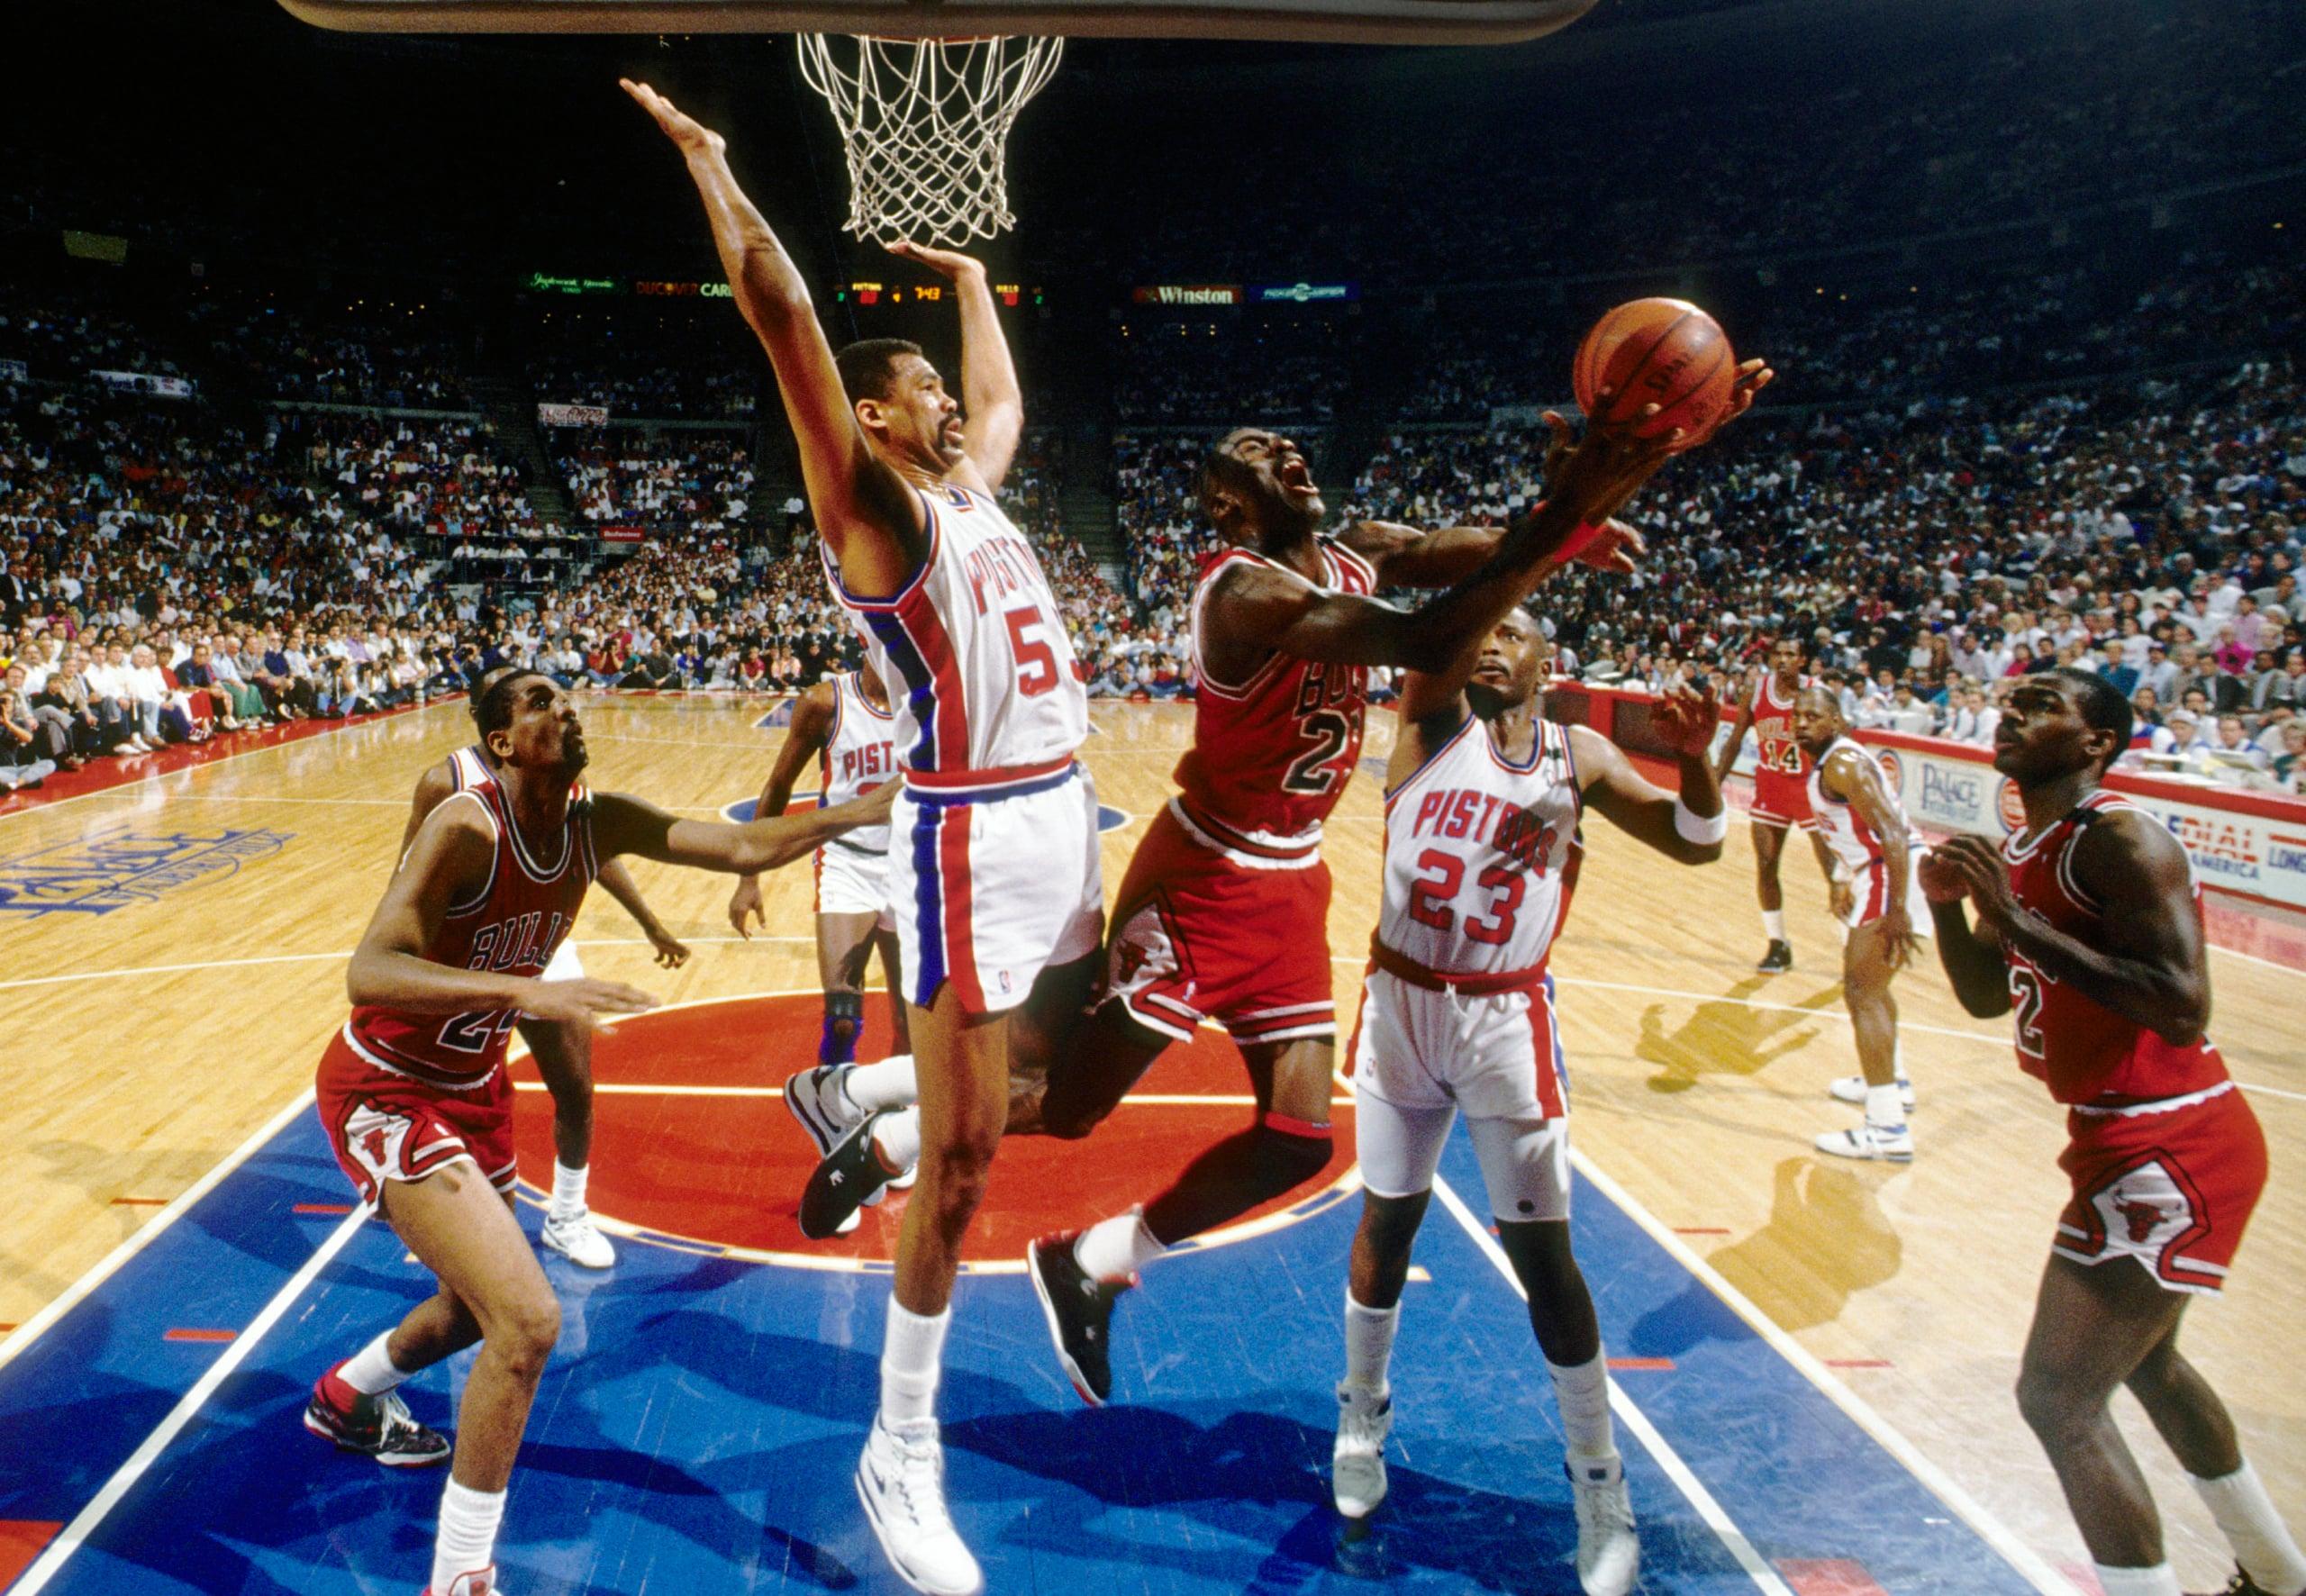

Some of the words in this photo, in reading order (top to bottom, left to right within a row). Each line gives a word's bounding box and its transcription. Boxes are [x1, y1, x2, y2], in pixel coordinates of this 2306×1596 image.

[1158, 286, 1233, 304] Winston
[1004, 604, 1085, 699] 5
[843, 740, 901, 782] PIST
[1765, 739, 1802, 774] 14
[1412, 789, 1557, 879] PISTONS
[1409, 848, 1526, 945] 23
[467, 911, 572, 972] BULL
